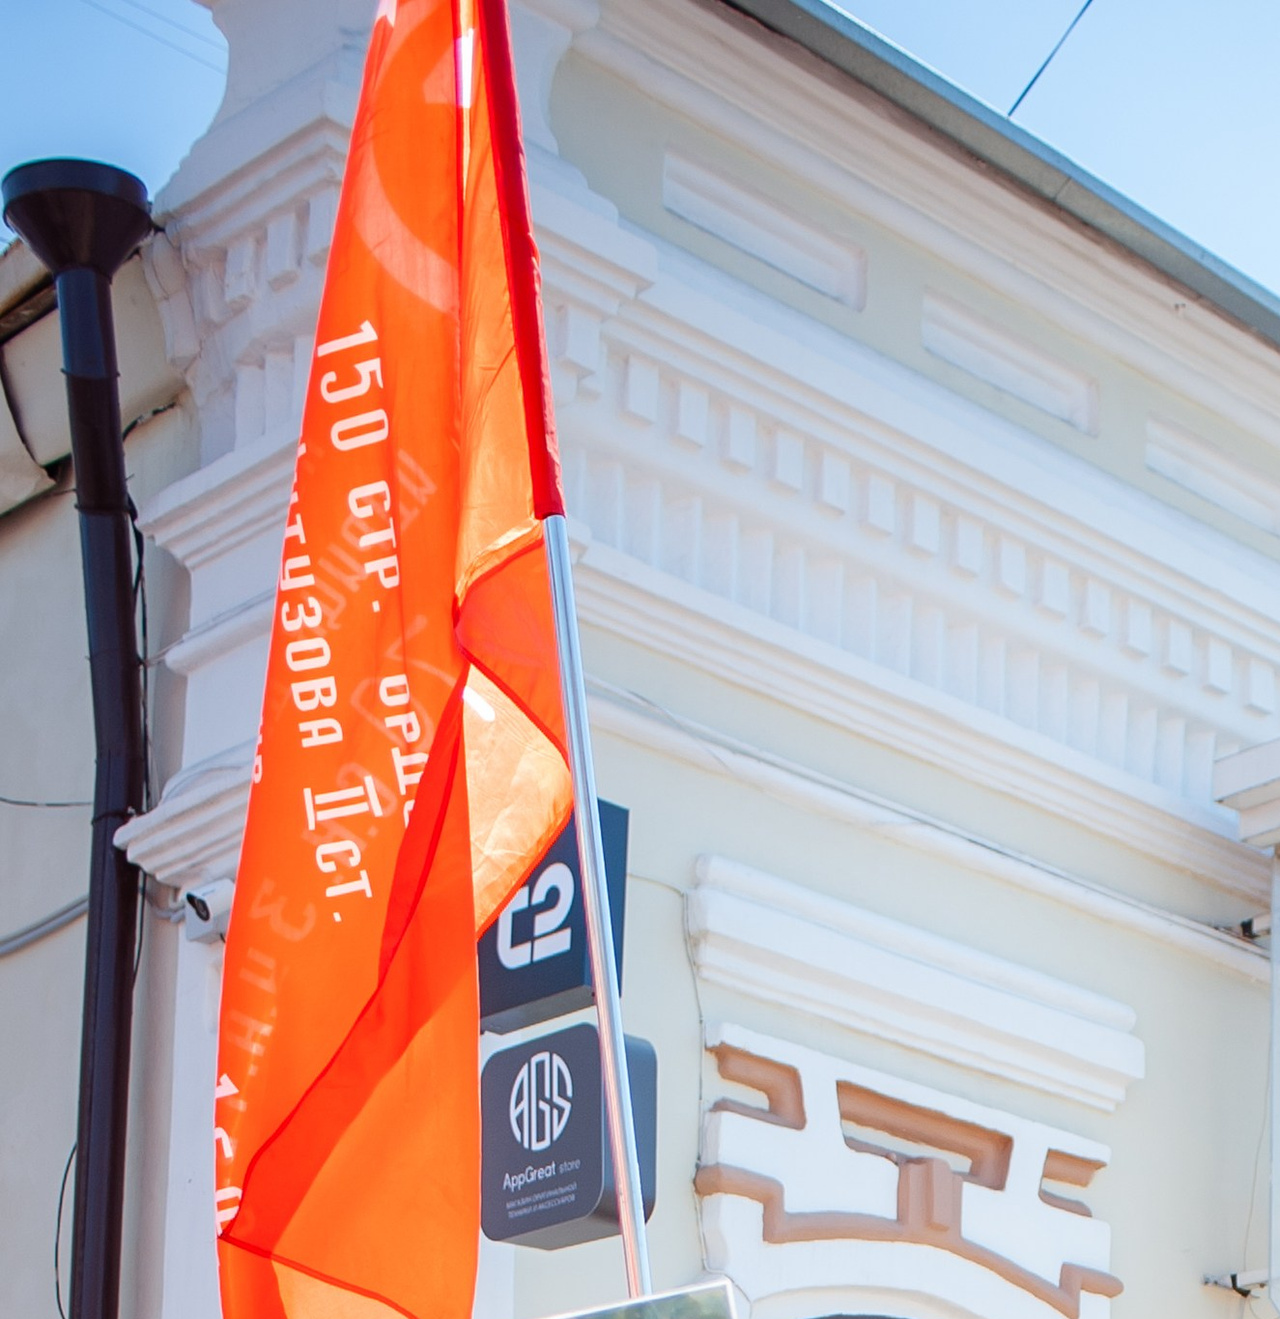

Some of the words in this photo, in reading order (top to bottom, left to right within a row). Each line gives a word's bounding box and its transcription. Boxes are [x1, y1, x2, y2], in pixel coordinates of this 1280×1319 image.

[317, 319, 389, 452] 150
[348, 479, 400, 613] СТР.
[379, 673, 430, 829] ОРД
[509, 1051, 573, 1151] AGS
[502, 1161, 556, 1192] AppGreat
[559, 1159, 581, 1174] store
